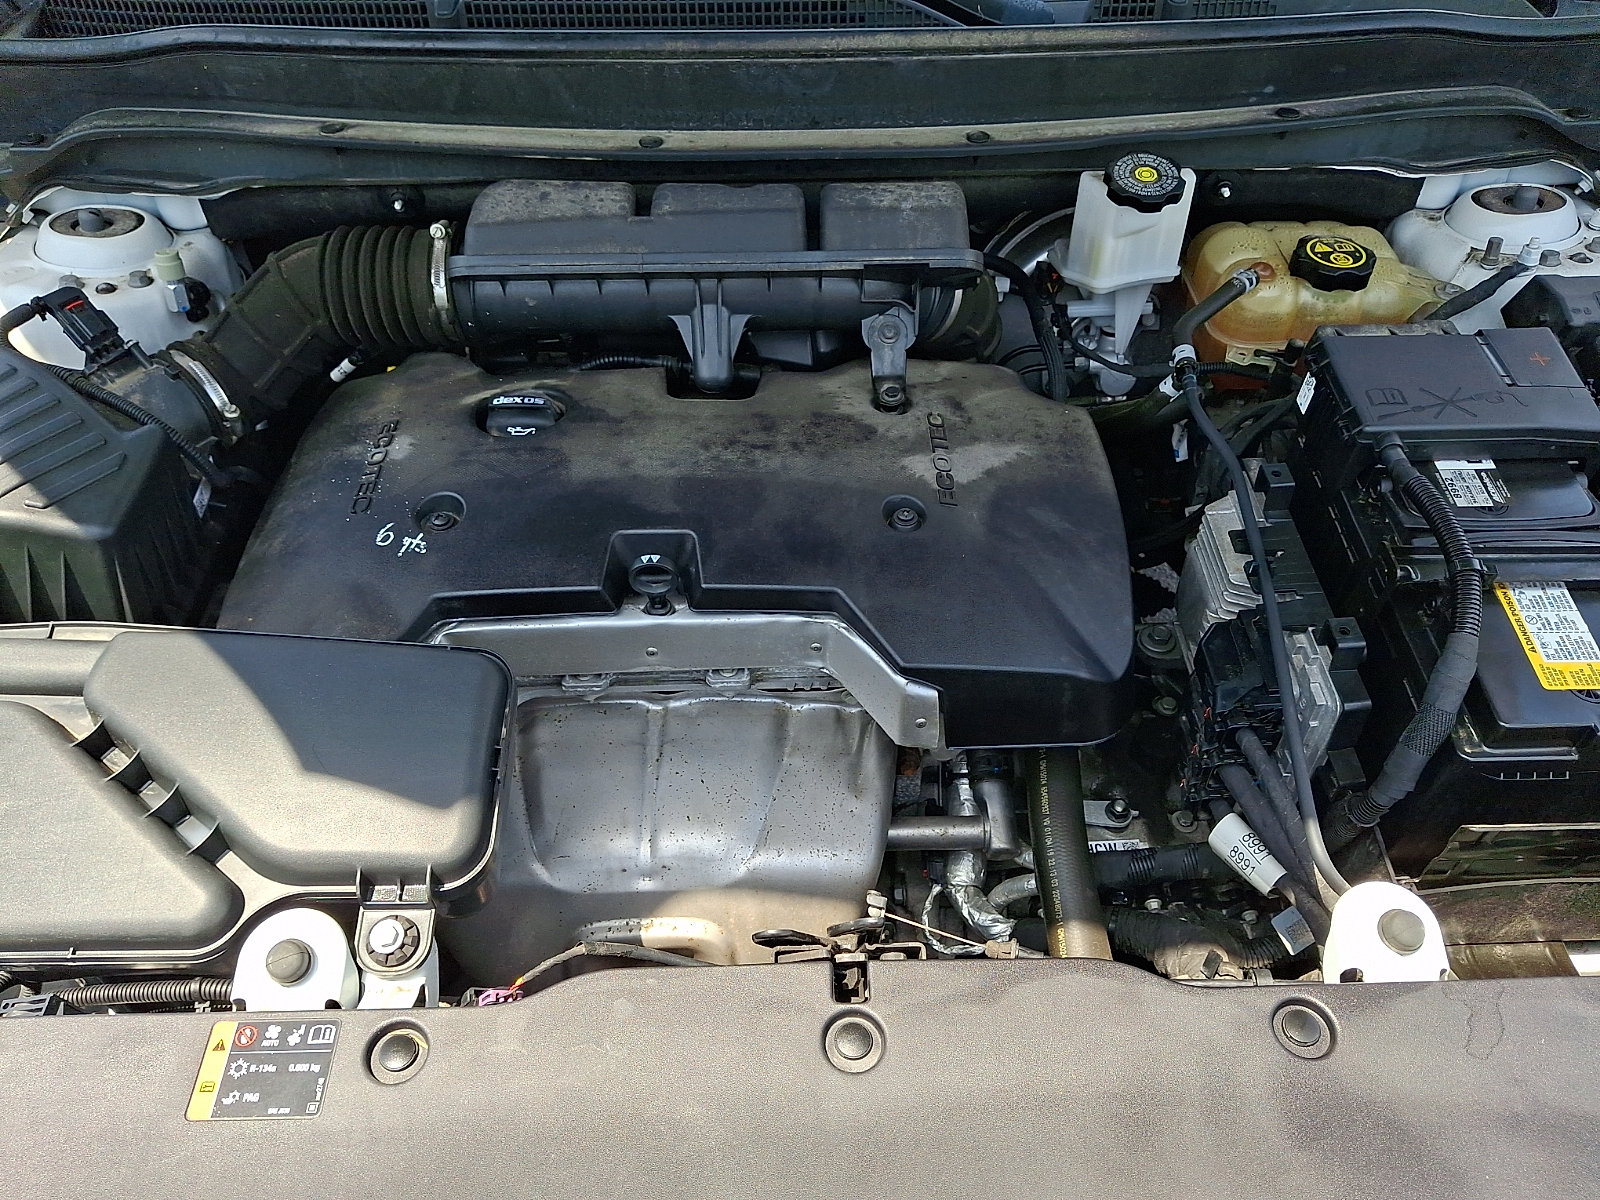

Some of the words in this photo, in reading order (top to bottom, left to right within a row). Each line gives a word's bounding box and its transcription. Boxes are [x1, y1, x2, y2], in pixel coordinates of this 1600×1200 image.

[493, 396, 546, 405] dexos
[351, 419, 399, 514] ECOTEC
[926, 411, 958, 506] ECOTEC
[376, 522, 395, 546] 6
[1501, 591, 1519, 616] POISON
[1515, 617, 1534, 646] DANGER
[1230, 845, 1256, 876] 8991
[1242, 832, 1271, 861] 8991
